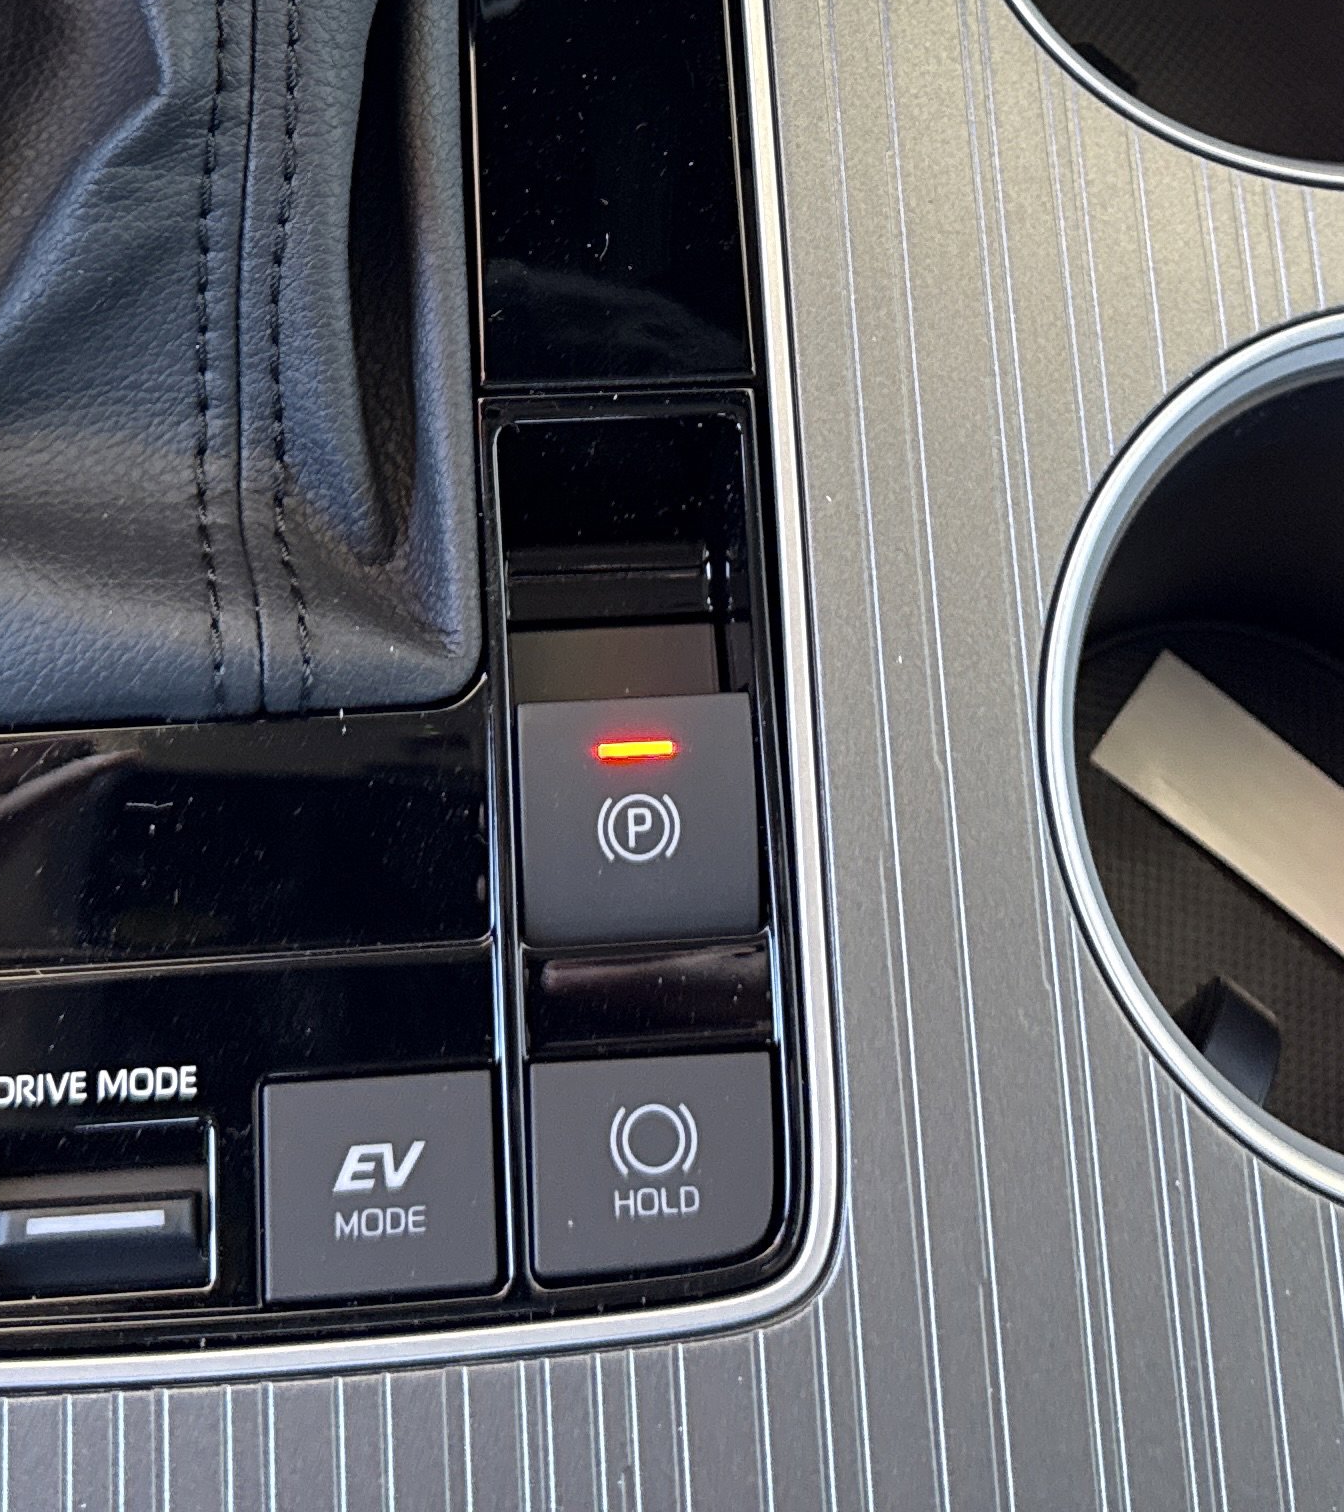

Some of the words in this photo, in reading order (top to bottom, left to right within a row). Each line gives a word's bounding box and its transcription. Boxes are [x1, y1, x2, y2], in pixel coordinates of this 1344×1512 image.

[96, 1064, 198, 1102] MODE
[332, 1140, 426, 1195] EV
[613, 1185, 701, 1220] HOLD
[335, 1205, 427, 1241] MODE
